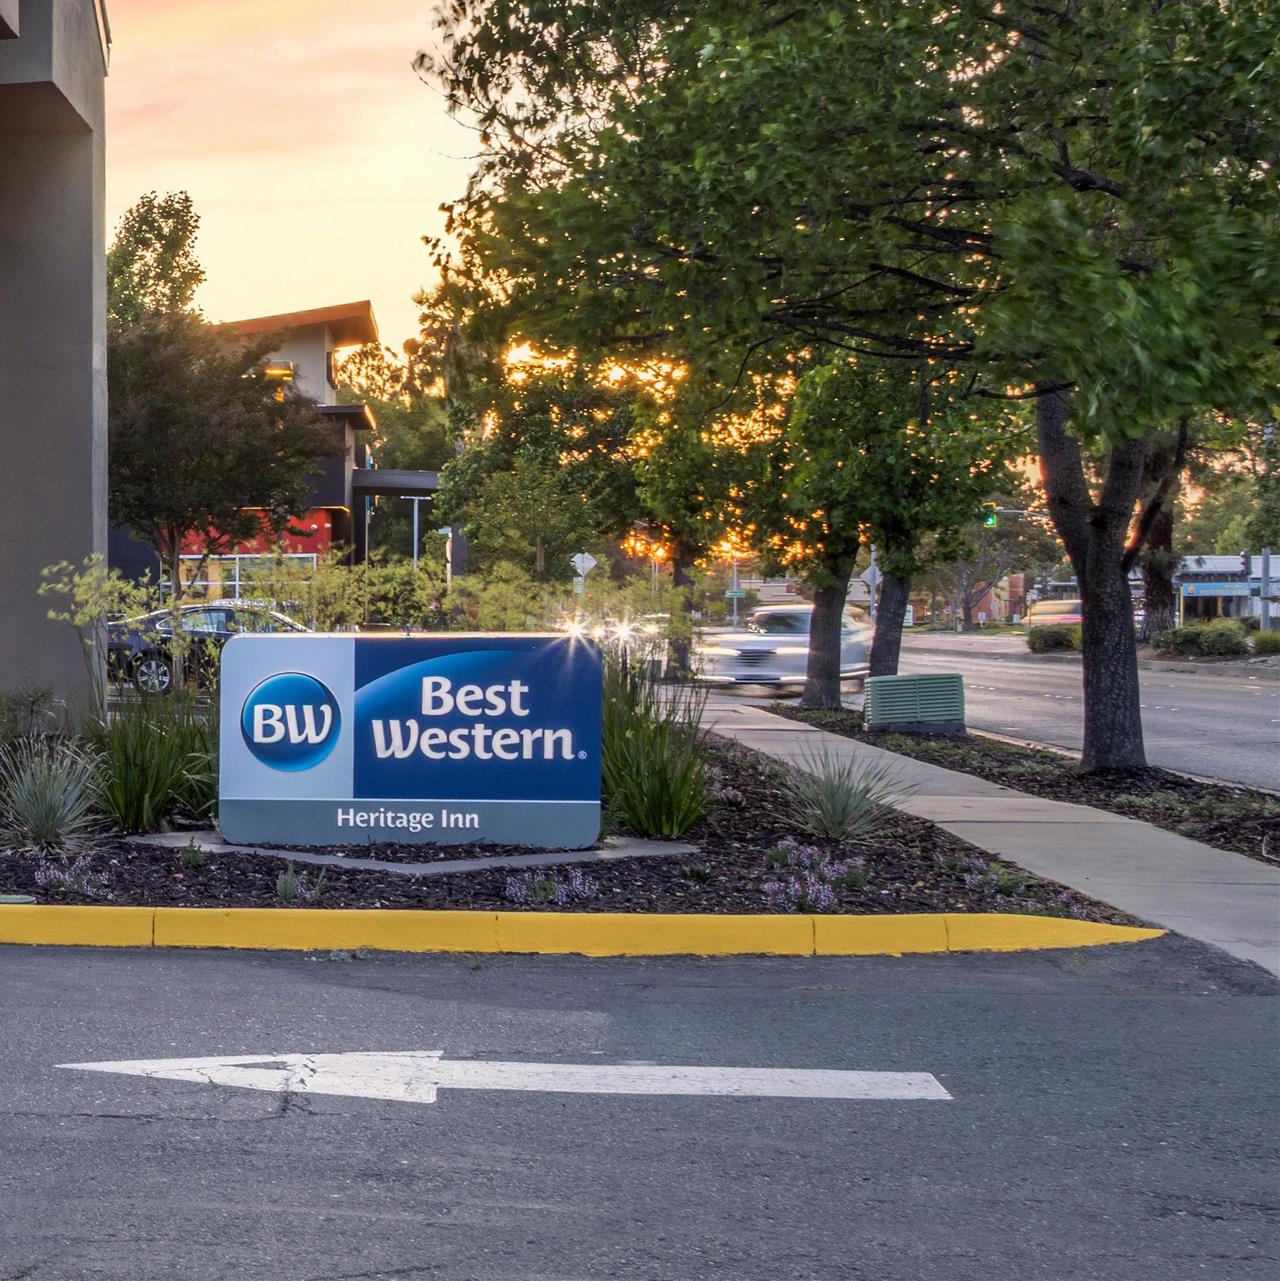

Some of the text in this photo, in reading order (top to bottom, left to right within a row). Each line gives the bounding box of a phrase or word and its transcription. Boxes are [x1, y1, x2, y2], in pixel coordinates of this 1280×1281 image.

[421, 675, 529, 717] Best
[253, 703, 332, 744] BW
[371, 719, 574, 759] Western
[337, 807, 434, 833] Heritage
[441, 808, 480, 829] Inn
